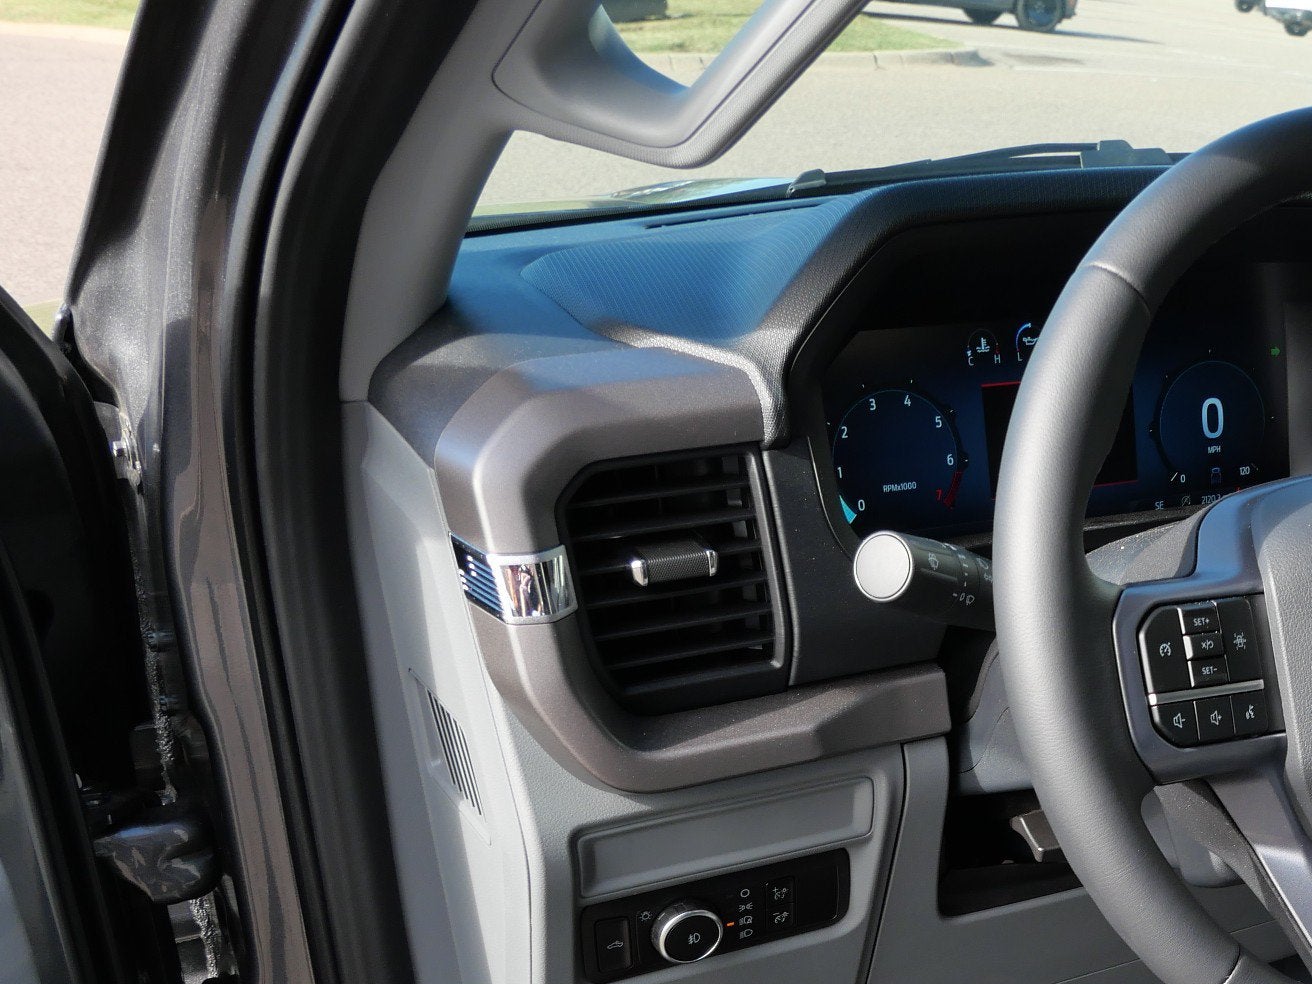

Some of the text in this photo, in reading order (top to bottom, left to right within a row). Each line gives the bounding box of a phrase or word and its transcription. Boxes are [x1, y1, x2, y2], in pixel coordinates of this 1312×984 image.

[994, 354, 1001, 364] H
[1017, 352, 1024, 362] L
[869, 398, 877, 411] 3
[904, 395, 912, 407] 4
[935, 416, 943, 428] 5
[1201, 397, 1224, 439] 0
[841, 426, 848, 439] 2
[1207, 445, 1221, 454] MPH
[947, 454, 954, 467] 6
[837, 467, 842, 479] 1
[1240, 466, 1251, 476] 120
[1180, 474, 1186, 484] 0
[883, 481, 917, 493] RPMx1000
[936, 488, 943, 501] 7
[858, 499, 866, 512] 0
[1154, 501, 1164, 511] SE
[1193, 617, 1210, 627] SET+
